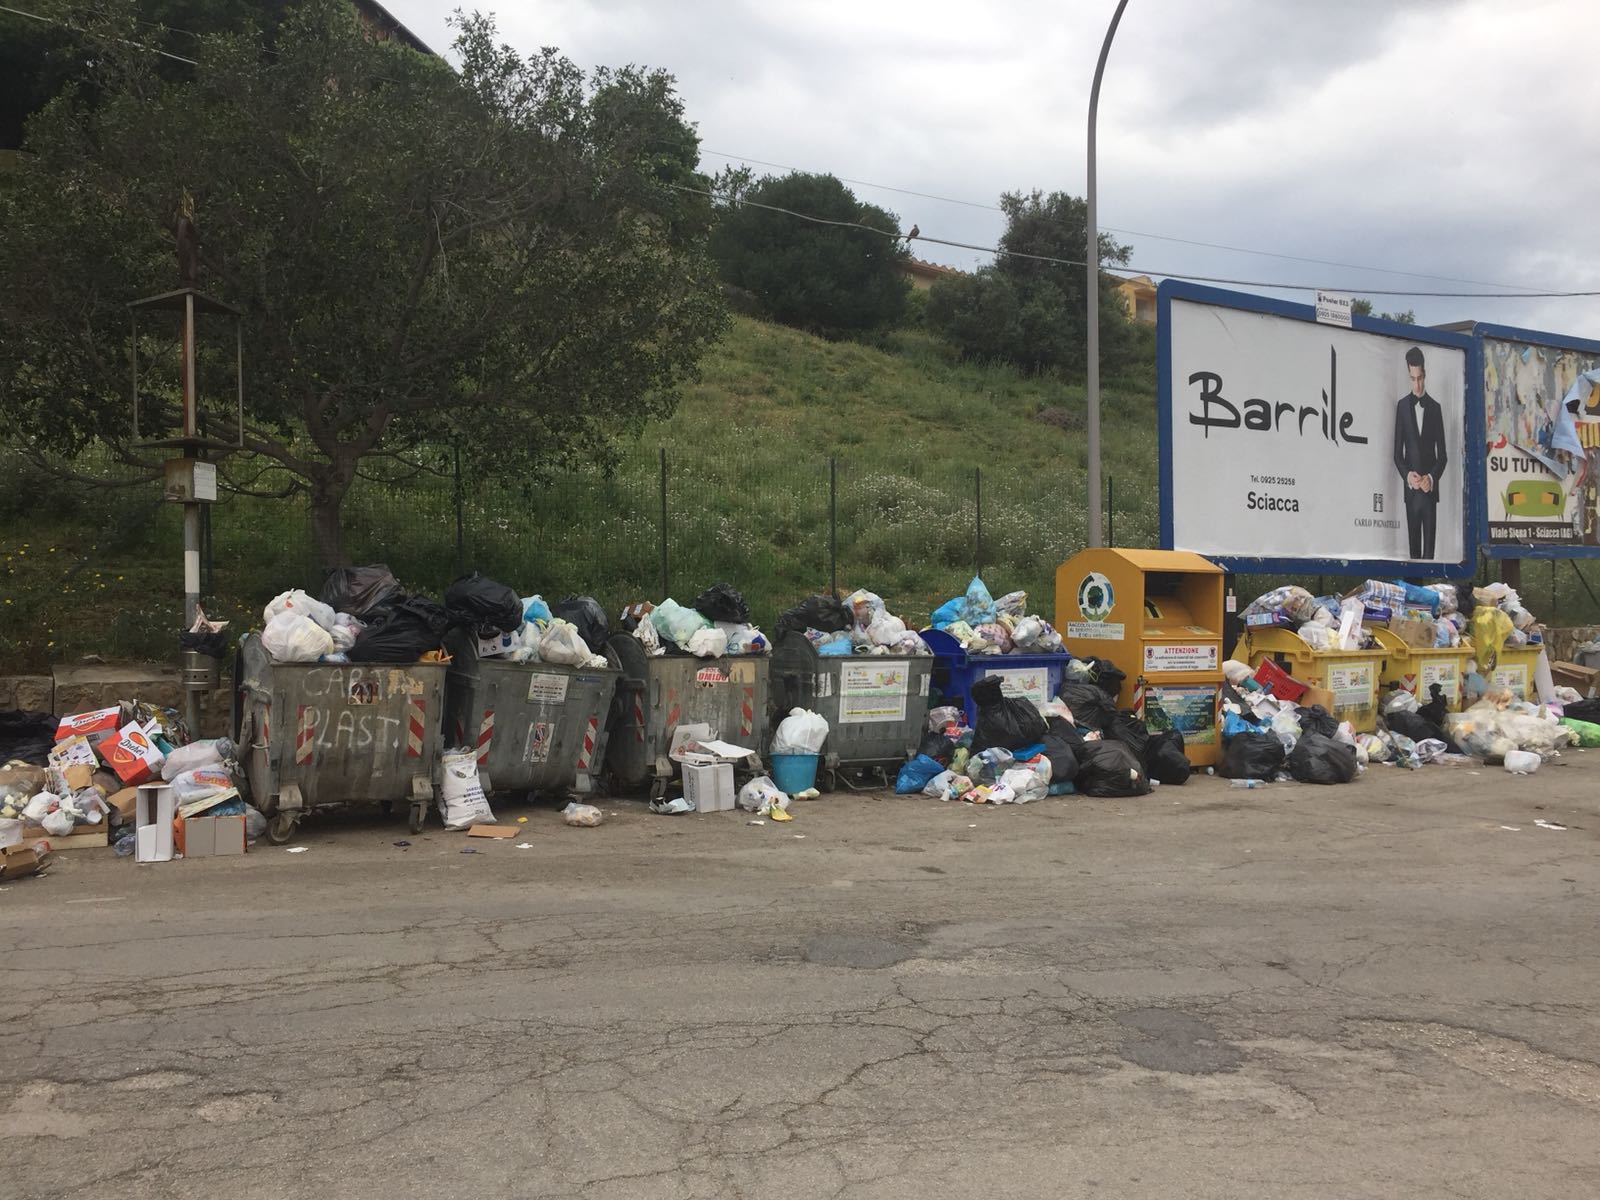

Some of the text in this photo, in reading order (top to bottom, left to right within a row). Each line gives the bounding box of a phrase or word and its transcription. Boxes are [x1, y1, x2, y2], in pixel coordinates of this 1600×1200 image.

[1188, 344, 1368, 447] Barrile
[1490, 456, 1508, 473] SU
[1511, 457, 1549, 474] TUTT
[1246, 491, 1300, 512] Sciacca
[1490, 527, 1508, 538] Viale
[1536, 527, 1560, 538] Sciacca
